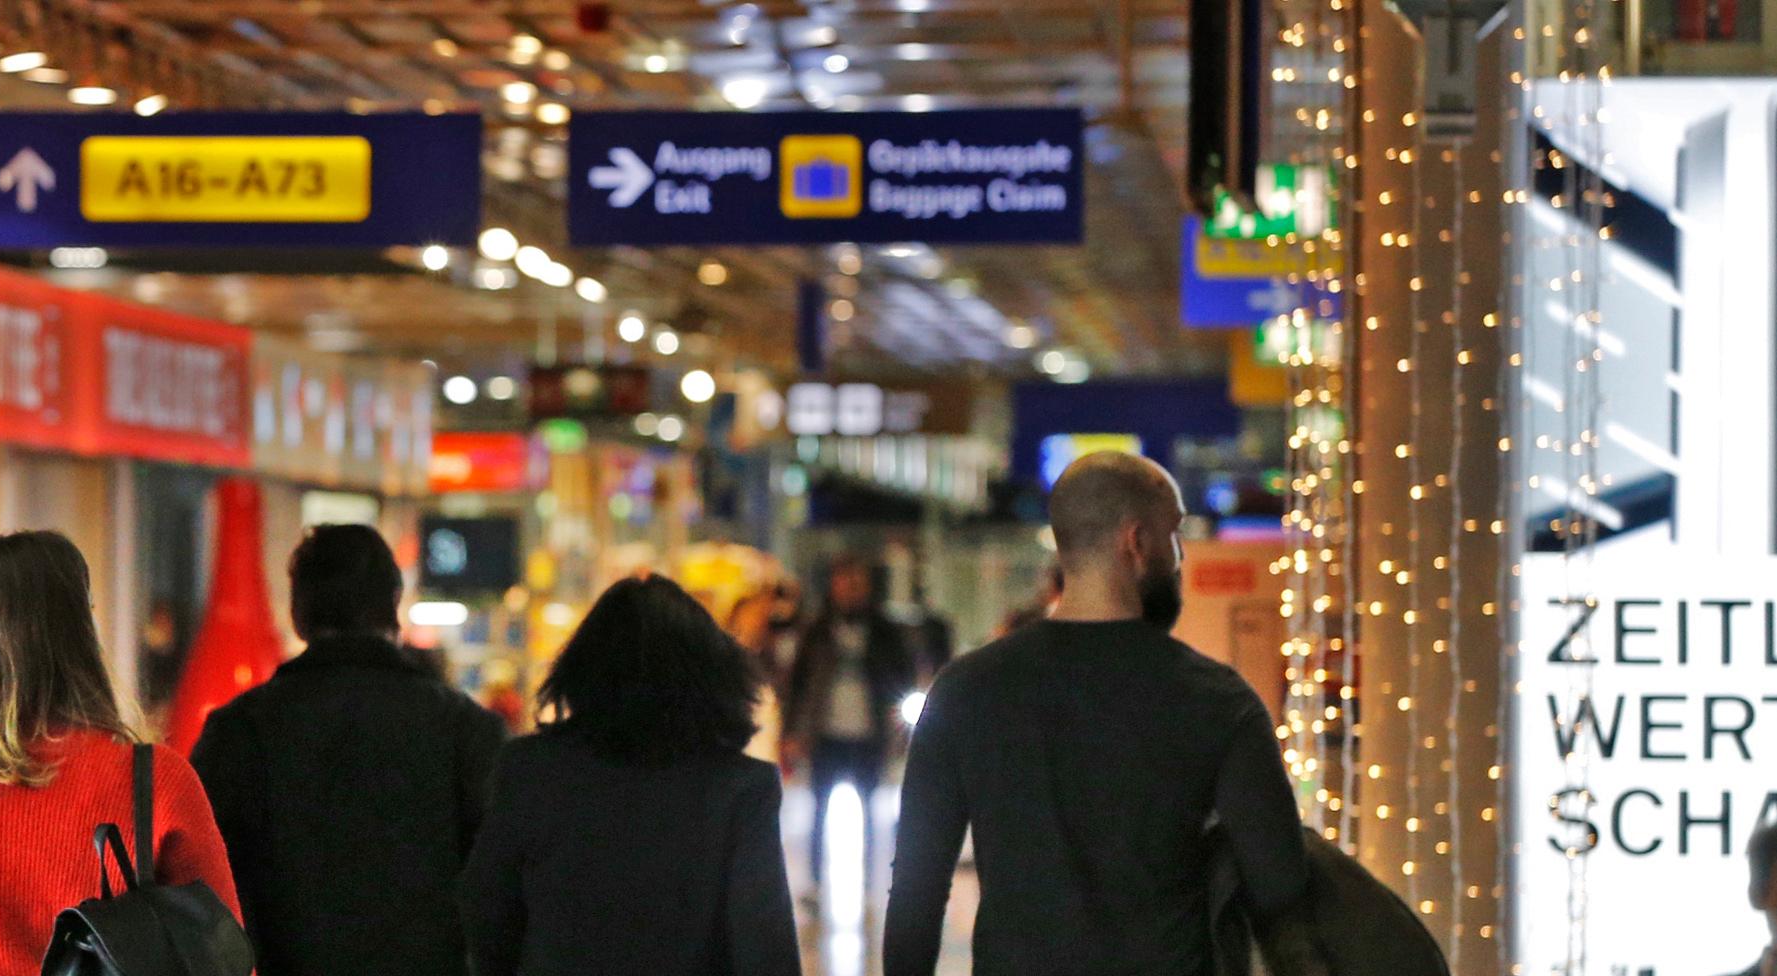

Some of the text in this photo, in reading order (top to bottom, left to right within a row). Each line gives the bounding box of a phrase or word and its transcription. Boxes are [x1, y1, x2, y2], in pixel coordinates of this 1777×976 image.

[654, 181, 712, 214] Exit
[869, 179, 1067, 219] Baggage Claim
[1547, 694, 1777, 761] WER
